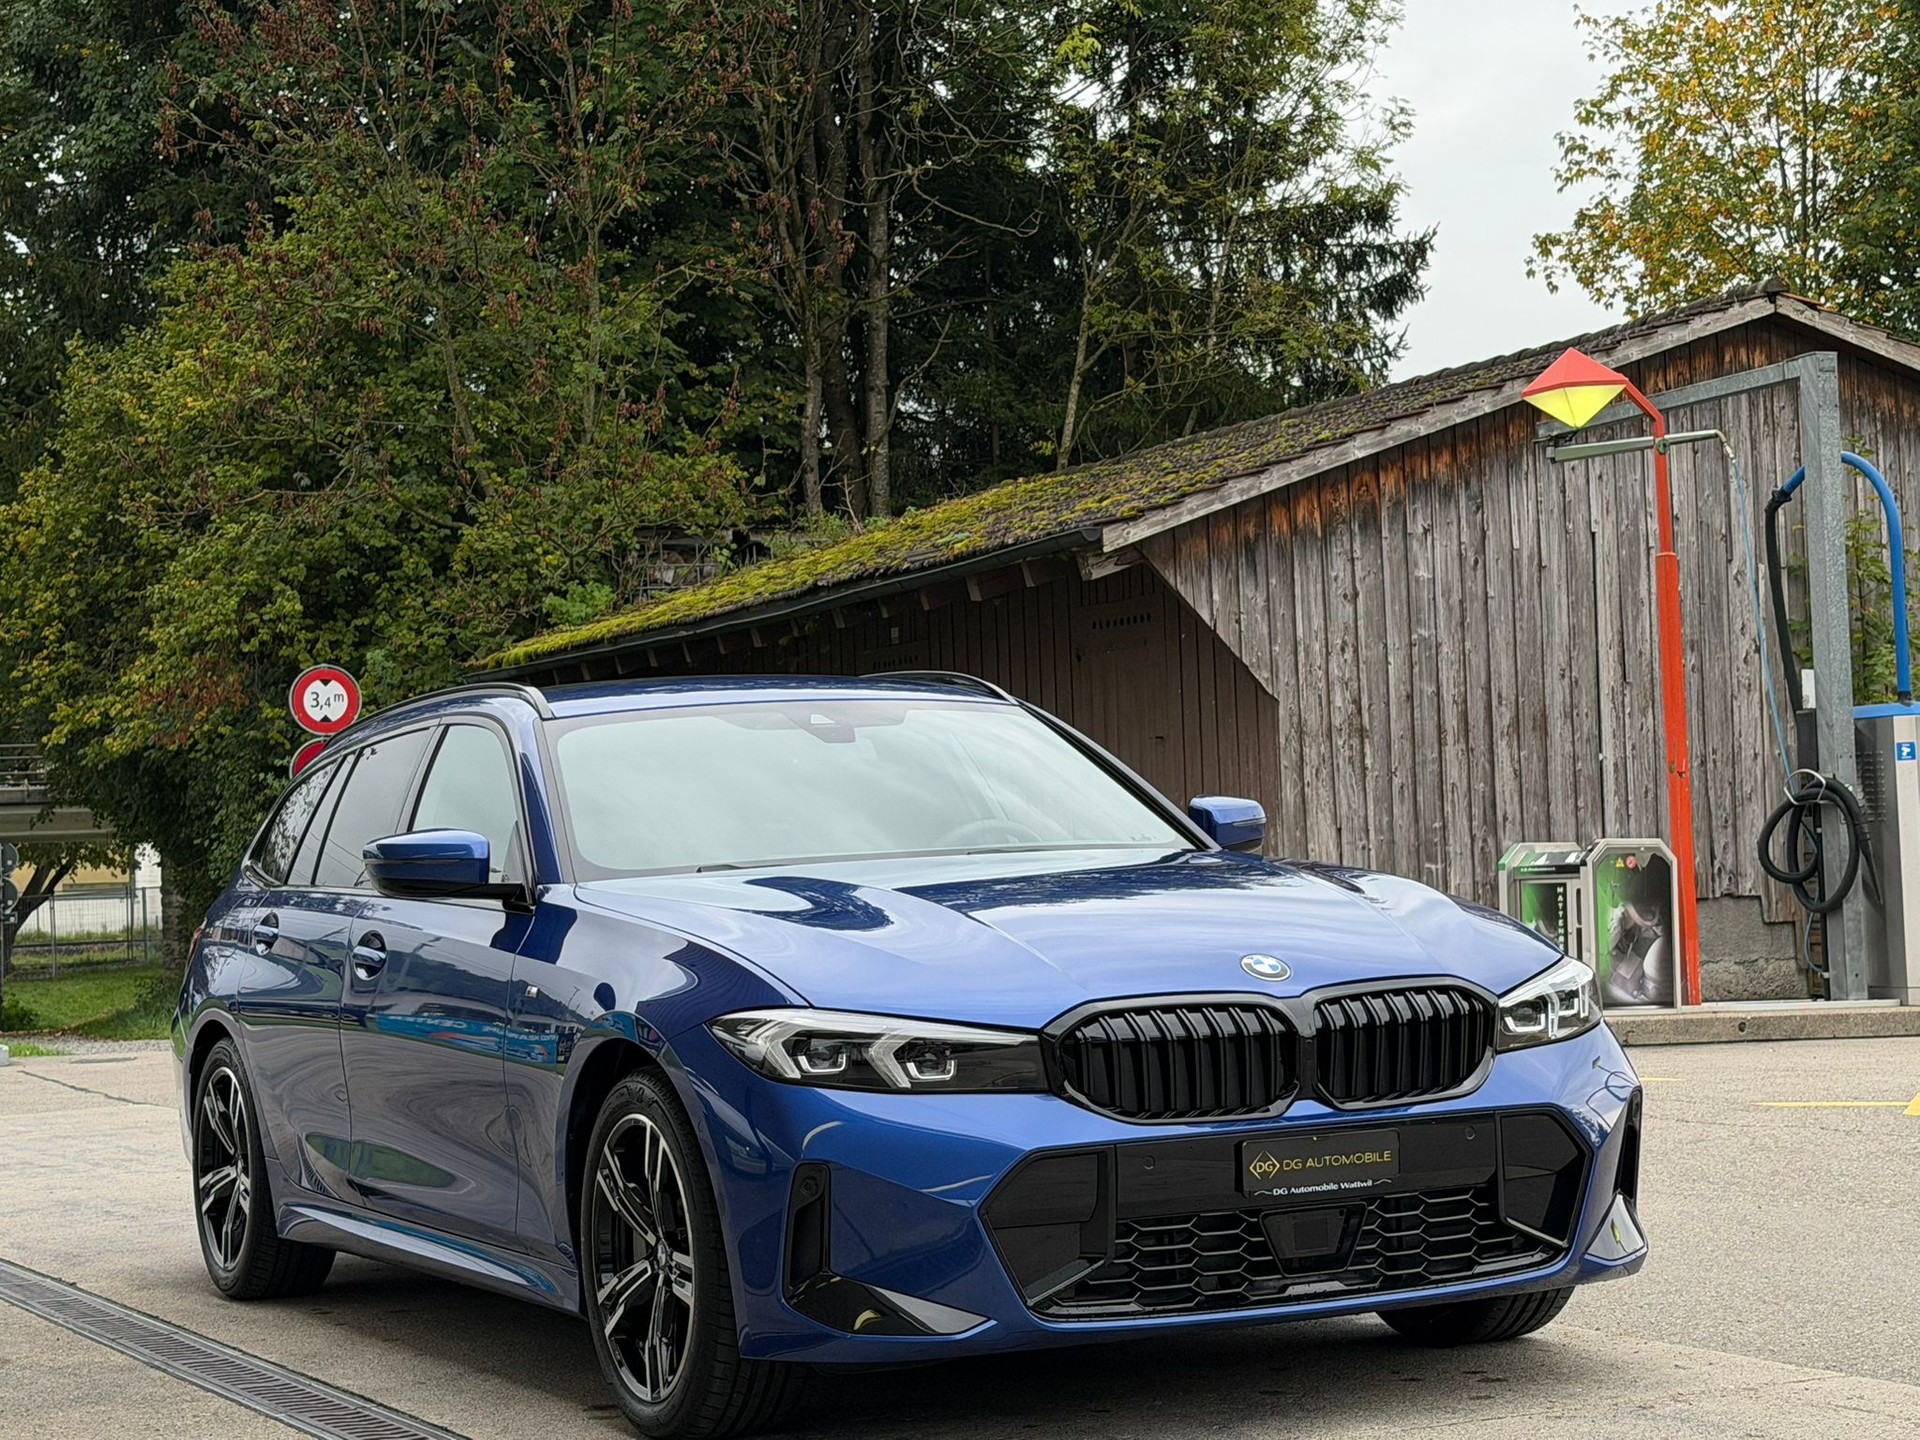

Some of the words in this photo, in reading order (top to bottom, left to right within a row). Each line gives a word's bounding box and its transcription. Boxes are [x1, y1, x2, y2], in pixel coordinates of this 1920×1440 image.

[1557, 886, 1565, 951] MATTENRE
[1256, 1161, 1273, 1173] DG
[1283, 1159, 1302, 1171] DG
[1305, 1150, 1392, 1169] AUTOMOBILE
[1273, 1187, 1288, 1196] DG
[1290, 1181, 1339, 1194] Automobile
